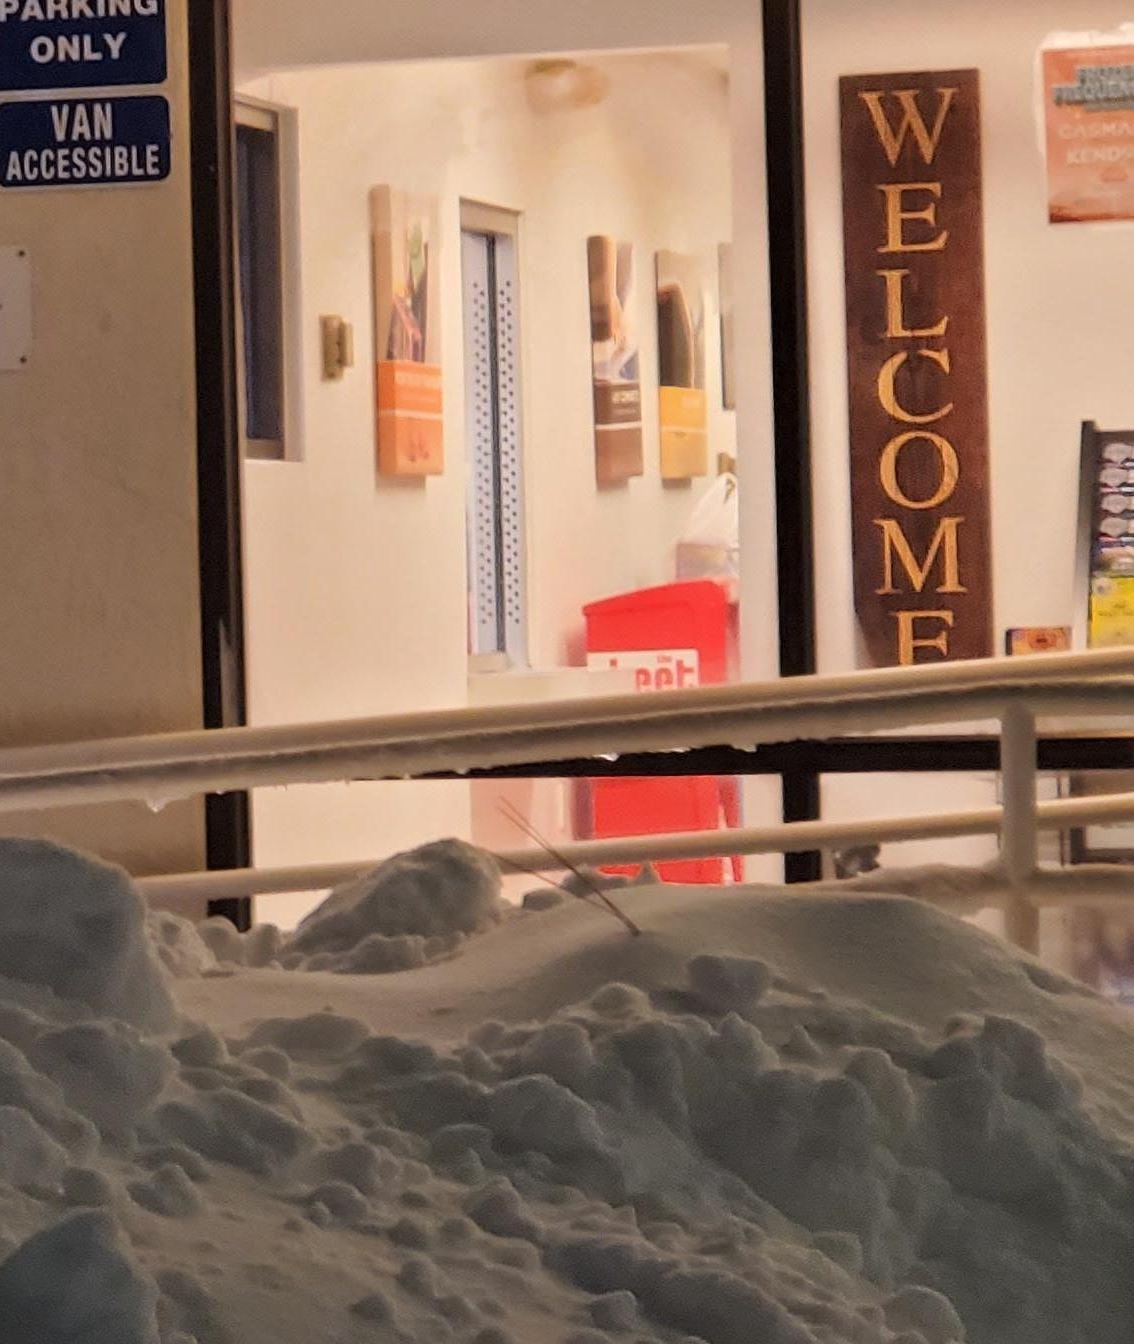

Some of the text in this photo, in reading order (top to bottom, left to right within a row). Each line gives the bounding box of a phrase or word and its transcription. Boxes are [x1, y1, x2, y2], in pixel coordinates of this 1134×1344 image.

[29, 32, 127, 64] ONLY
[50, 102, 113, 143] VAN
[5, 144, 160, 181] ACCESSIBLE
[858, 86, 967, 666] WELCOME
